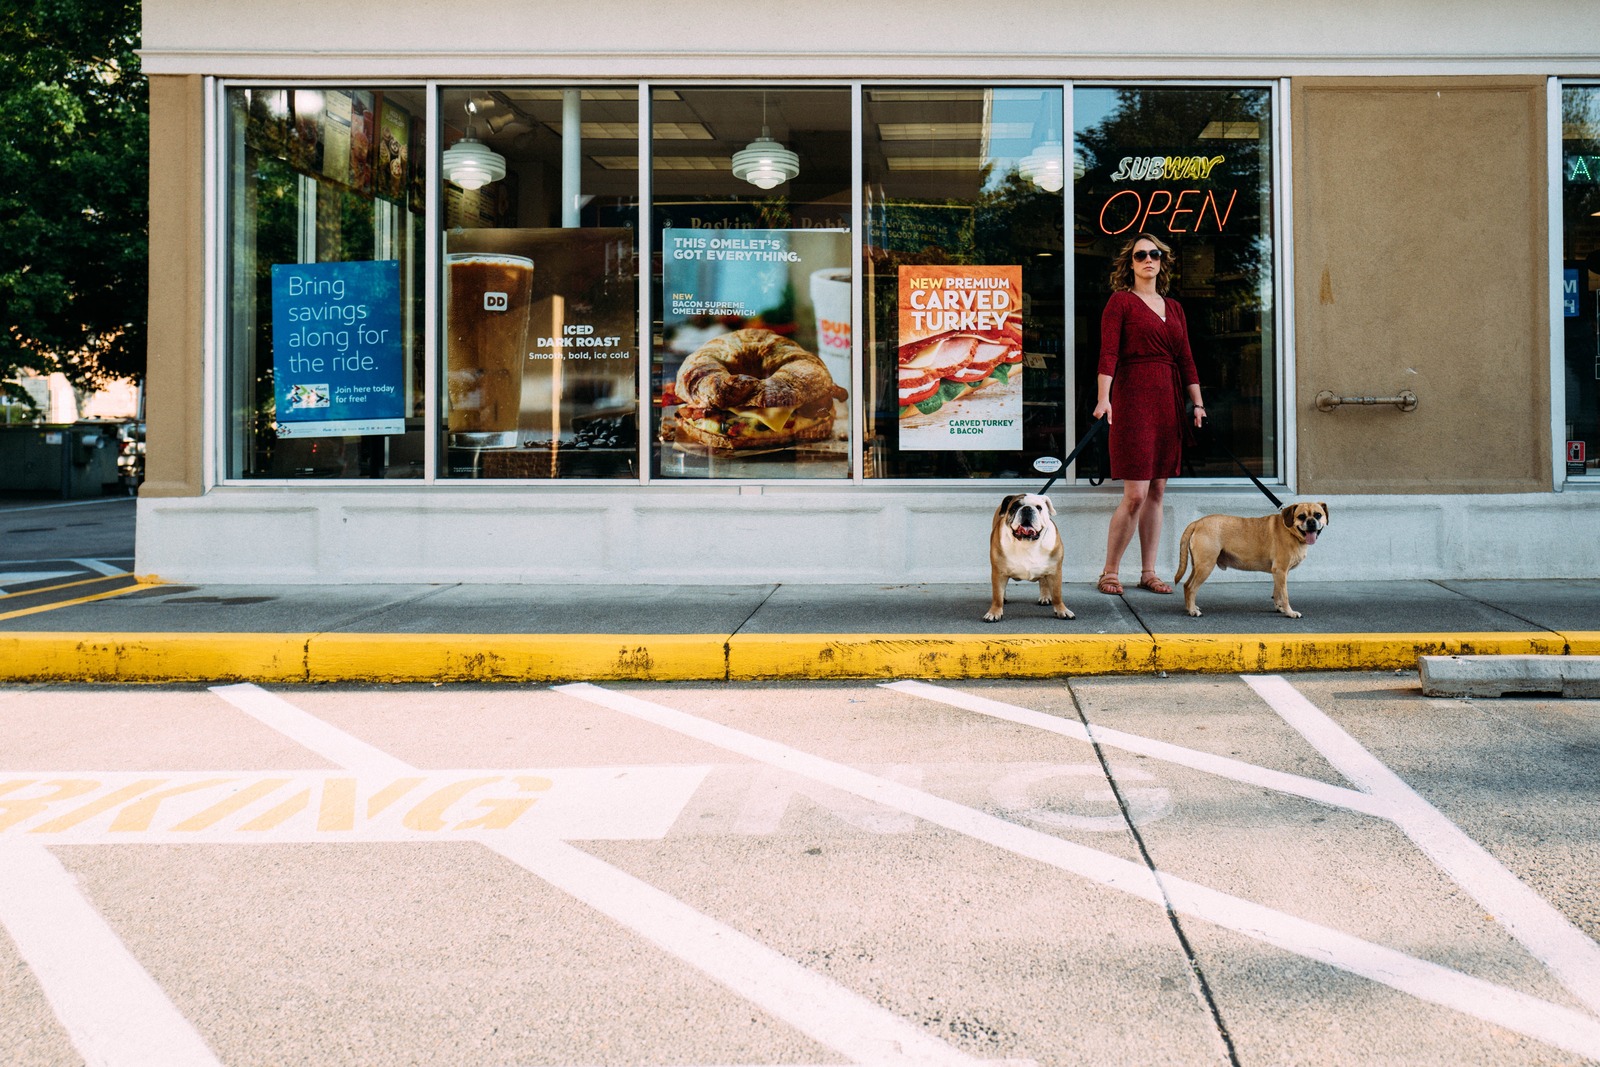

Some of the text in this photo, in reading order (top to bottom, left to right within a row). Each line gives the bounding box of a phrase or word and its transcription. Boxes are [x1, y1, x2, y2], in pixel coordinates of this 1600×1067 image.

[1110, 155, 1225, 182] SUBWAY
[1100, 189, 1237, 234] OPEN
[674, 237, 780, 250] THIS OMELET'S
[673, 249, 801, 262] GOT EVERYTHING.
[289, 276, 345, 300] Bring
[910, 277, 1010, 289] NEW PREMIUM
[487, 296, 506, 307] DD
[672, 300, 745, 309] BACON SUPREME
[910, 290, 1010, 310] CARVED
[288, 302, 367, 326] savings
[708, 308, 756, 316] SANDWICH
[911, 311, 1010, 331] TURKEY
[563, 325, 594, 335] ICED
[289, 323, 389, 352] along for
[537, 337, 621, 348] DARK ROAST
[288, 350, 378, 373] the ride.
[568, 351, 592, 360] bold,
[594, 351, 607, 359] ice
[609, 351, 630, 359] cold
[335, 384, 395, 394] Join here today
[349, 395, 367, 403] free!
[949, 419, 1014, 427] CARVED TURKEY
[949, 427, 955, 435] &
